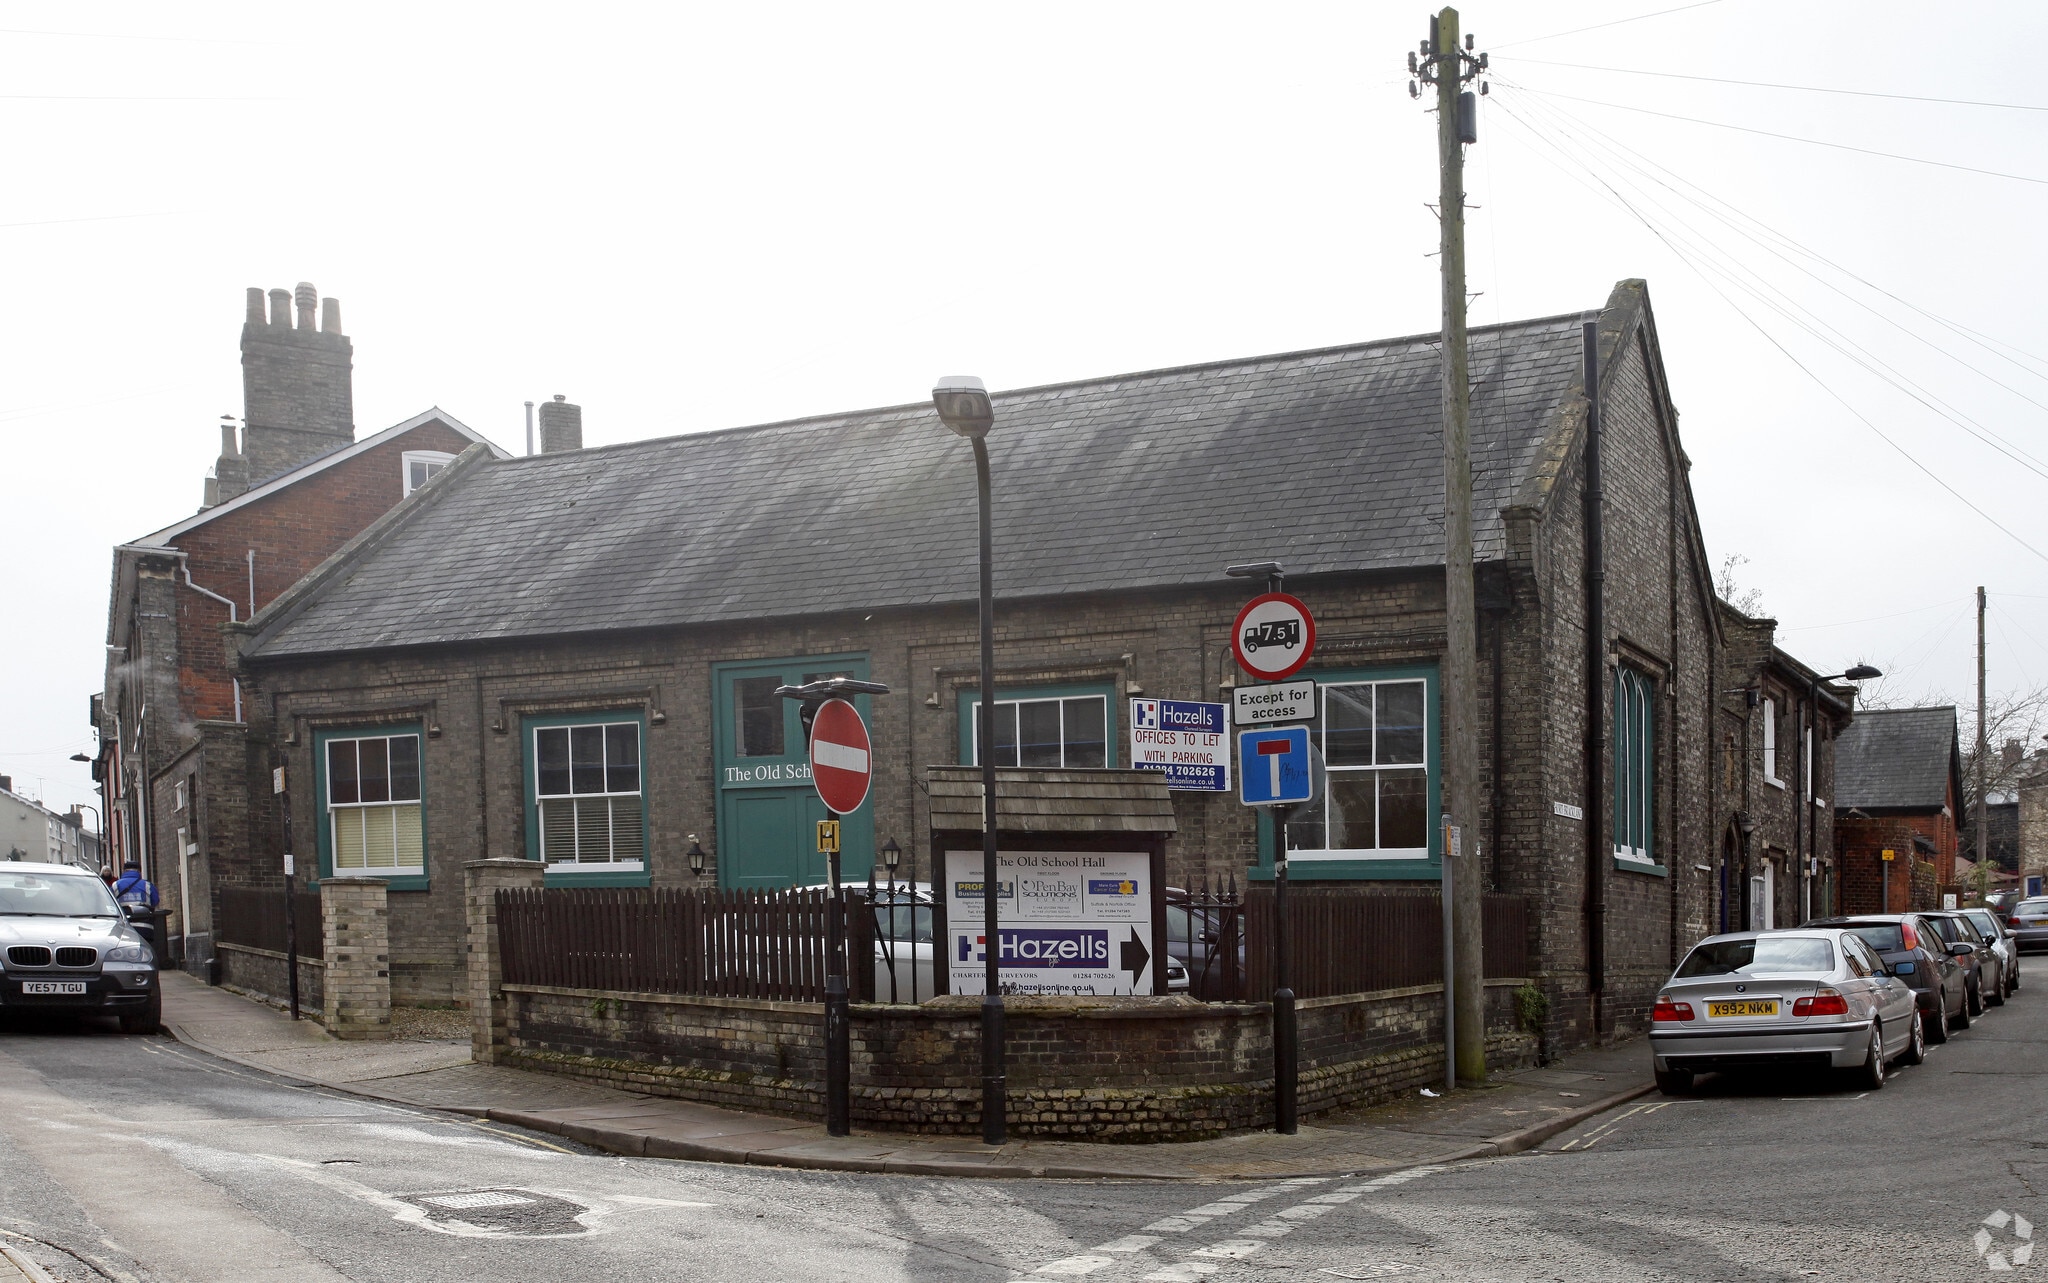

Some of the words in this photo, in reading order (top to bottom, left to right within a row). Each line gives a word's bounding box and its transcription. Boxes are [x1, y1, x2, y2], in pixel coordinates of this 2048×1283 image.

[1240, 691, 1284, 706] Except
[1289, 690, 1308, 701] for
[1163, 704, 1213, 725] Hazells
[1252, 706, 1296, 719] access
[1135, 730, 1176, 745] OFFICES
[1182, 733, 1196, 746] TO
[1203, 733, 1220, 747] LET
[1144, 750, 1166, 762] WITH
[1172, 751, 1213, 764] PARKING
[725, 766, 751, 781] The
[755, 764, 781, 780] Old
[786, 763, 811, 779] Sch
[1176, 766, 1215, 776] 702626
[1166, 776, 1215, 785] zellsonline.co.uk
[820, 824, 835, 849] H
[1017, 856, 1038, 867] Old
[1041, 857, 1079, 867] School
[1082, 857, 1106, 868] Hall
[998, 934, 1107, 959] Hazells
[28, 983, 57, 993] YE57
[61, 983, 83, 993] TGU
[1714, 1004, 1745, 1015] X992
[1748, 1003, 1773, 1014] NKM
